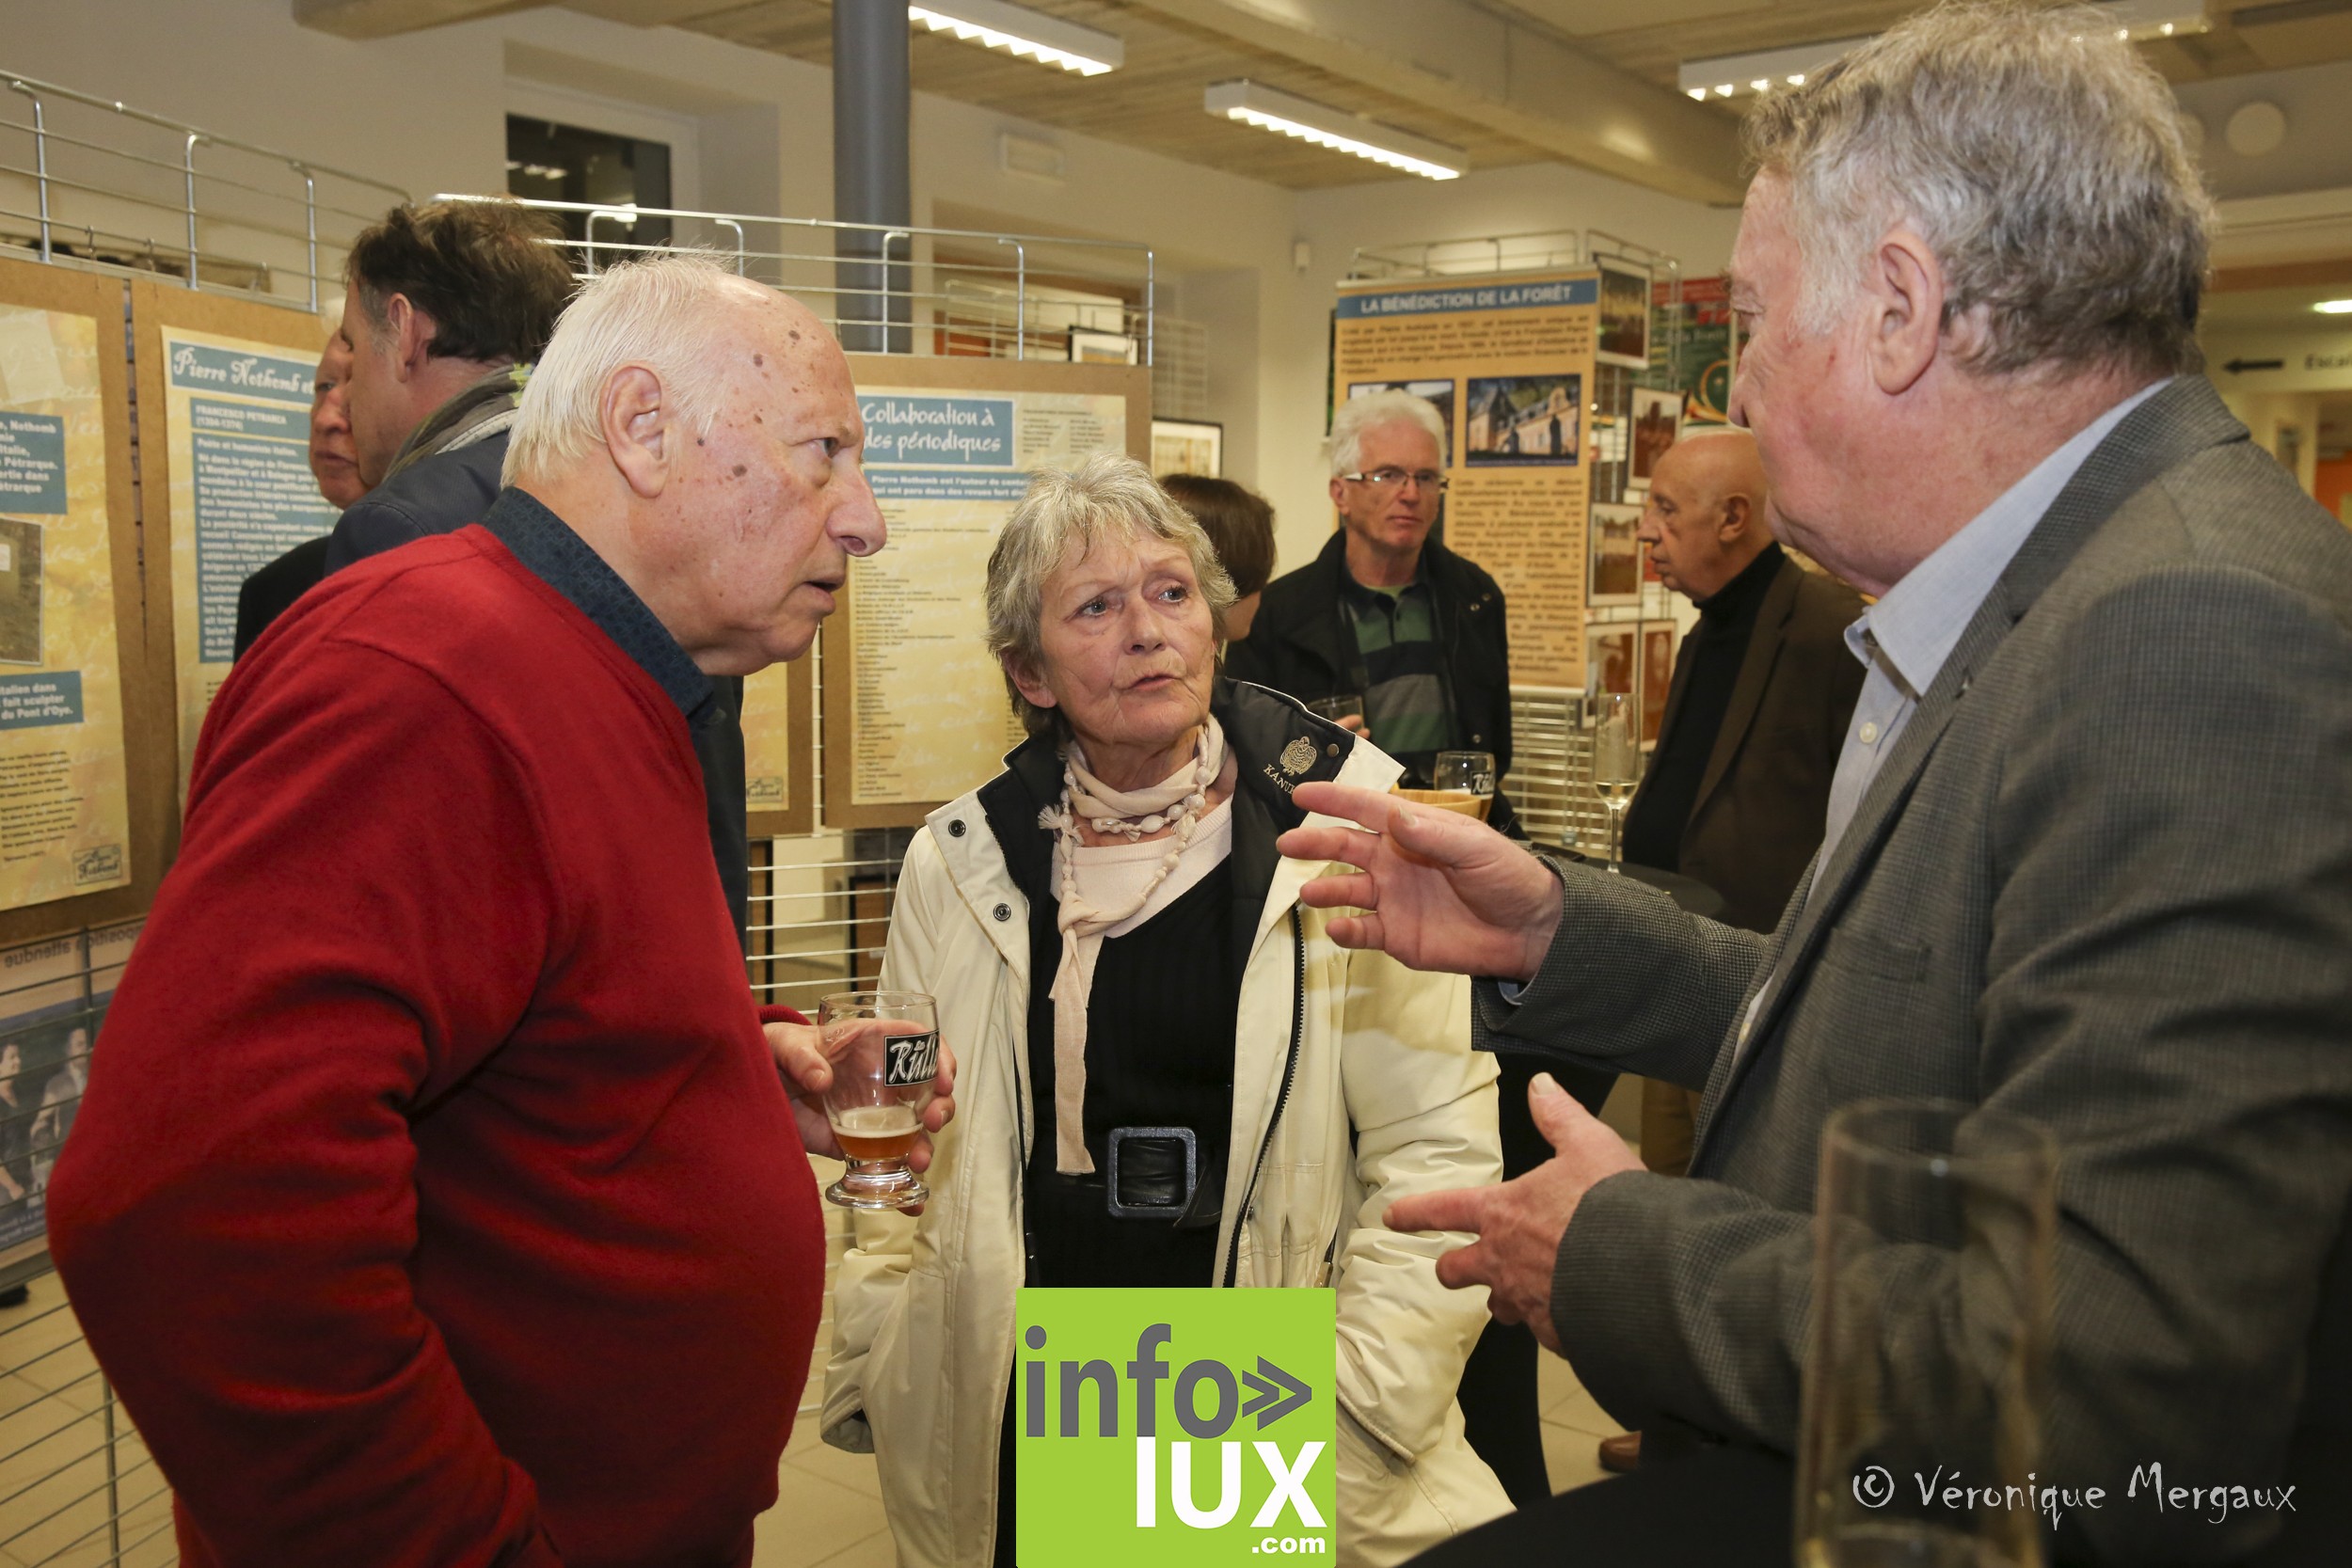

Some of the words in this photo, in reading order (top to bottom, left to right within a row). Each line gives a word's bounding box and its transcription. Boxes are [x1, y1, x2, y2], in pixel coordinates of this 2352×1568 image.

[1360, 298, 1379, 314] LA
[1380, 293, 1474, 312] BÉNÉDICTION
[1476, 291, 1497, 308] DE
[1500, 289, 1520, 305] LA
[1522, 284, 1572, 302] FORÊT
[173, 347, 227, 382] Pierre
[230, 357, 301, 393] Nothomb
[862, 401, 977, 427] Collaboration
[981, 408, 995, 427] à
[10, 420, 56, 435] Nothomb
[864, 427, 892, 449] des
[898, 429, 1002, 462] périodiques
[872, 475, 898, 484] Pierre
[899, 475, 938, 485] Nothomb
[940, 476, 954, 485] est
[887, 487, 901, 496] ont
[925, 487, 946, 497] dans
[947, 487, 962, 497] des
[32, 682, 56, 693] dans
[23, 694, 65, 706] sculpter
[17, 707, 40, 719] Pont
